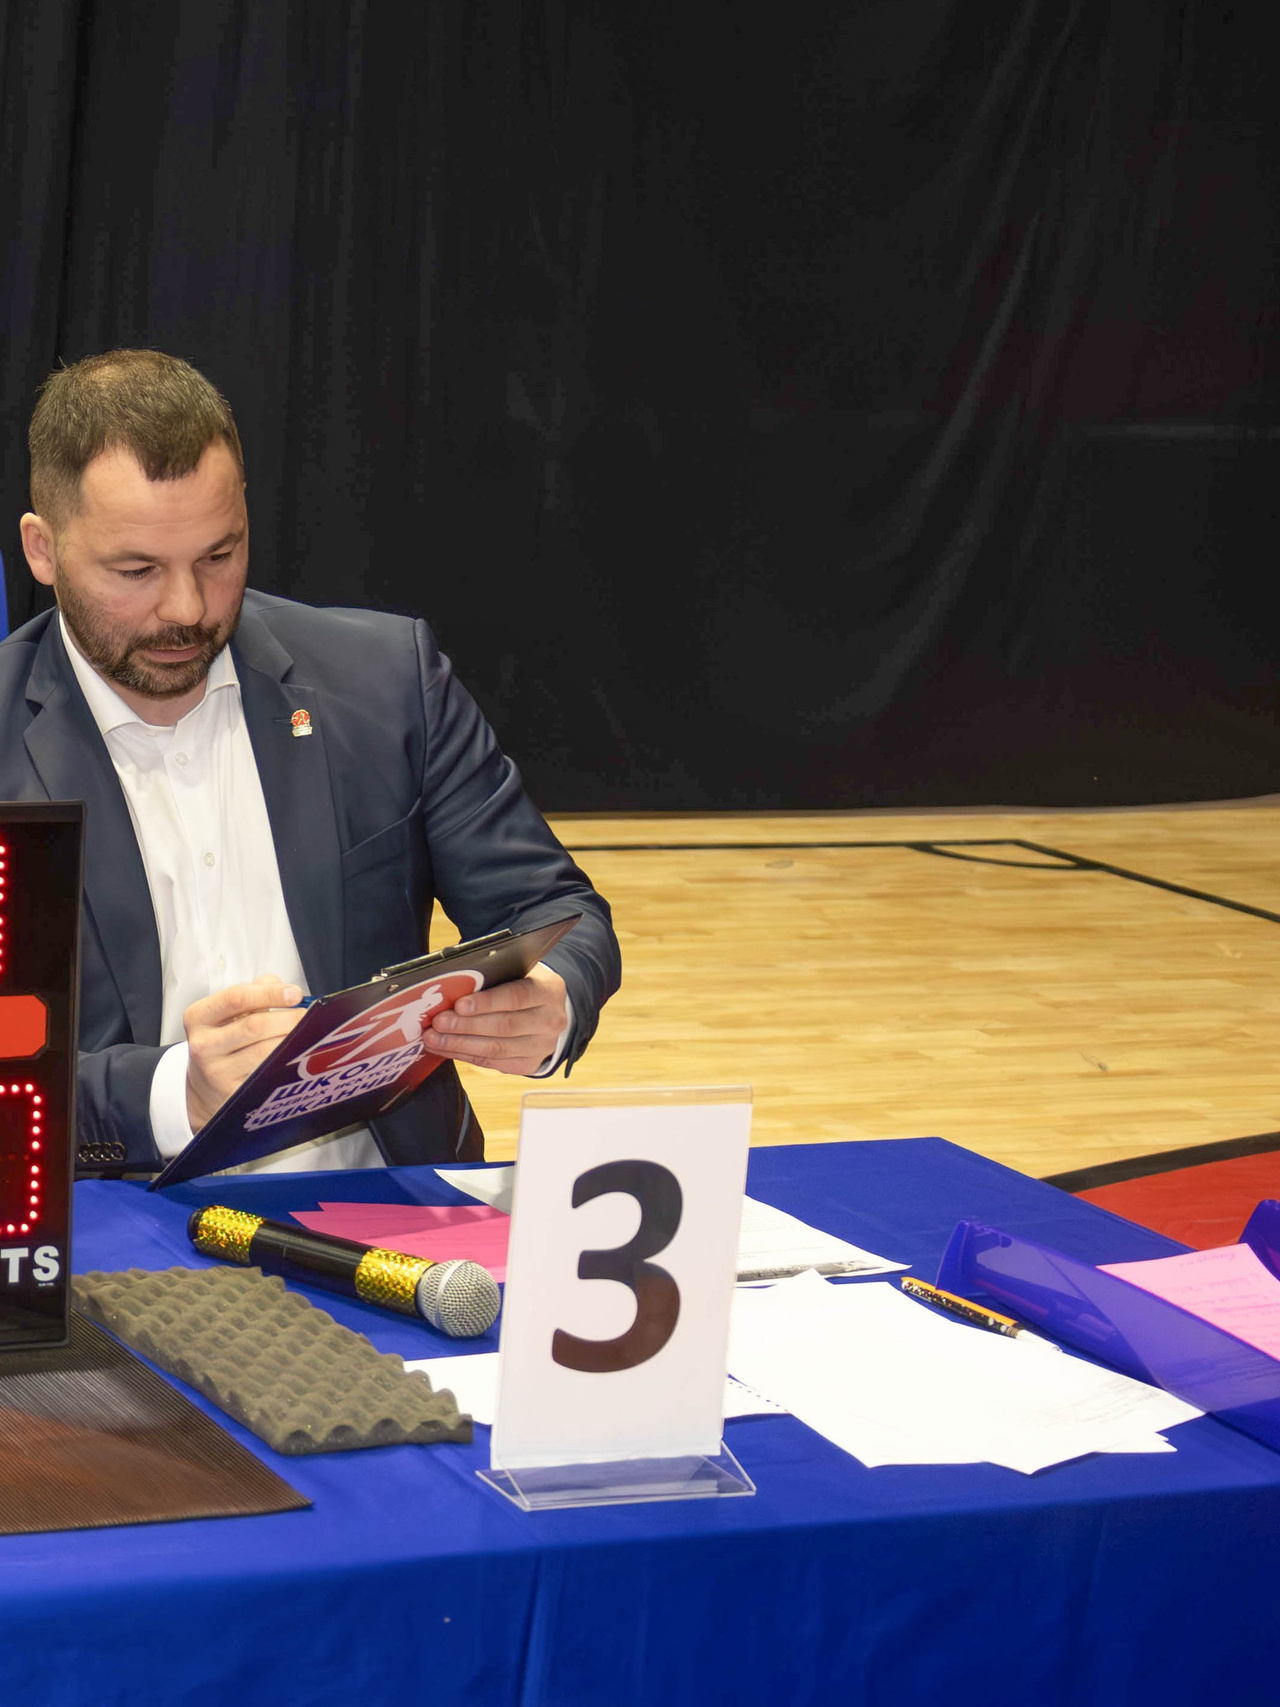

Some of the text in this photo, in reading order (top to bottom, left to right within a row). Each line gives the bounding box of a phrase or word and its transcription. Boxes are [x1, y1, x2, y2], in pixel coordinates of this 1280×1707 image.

[251, 1070, 400, 1126] ЧИКАНЧИ
[270, 1043, 422, 1103] ШКОЛА
[551, 1159, 683, 1373] 3
